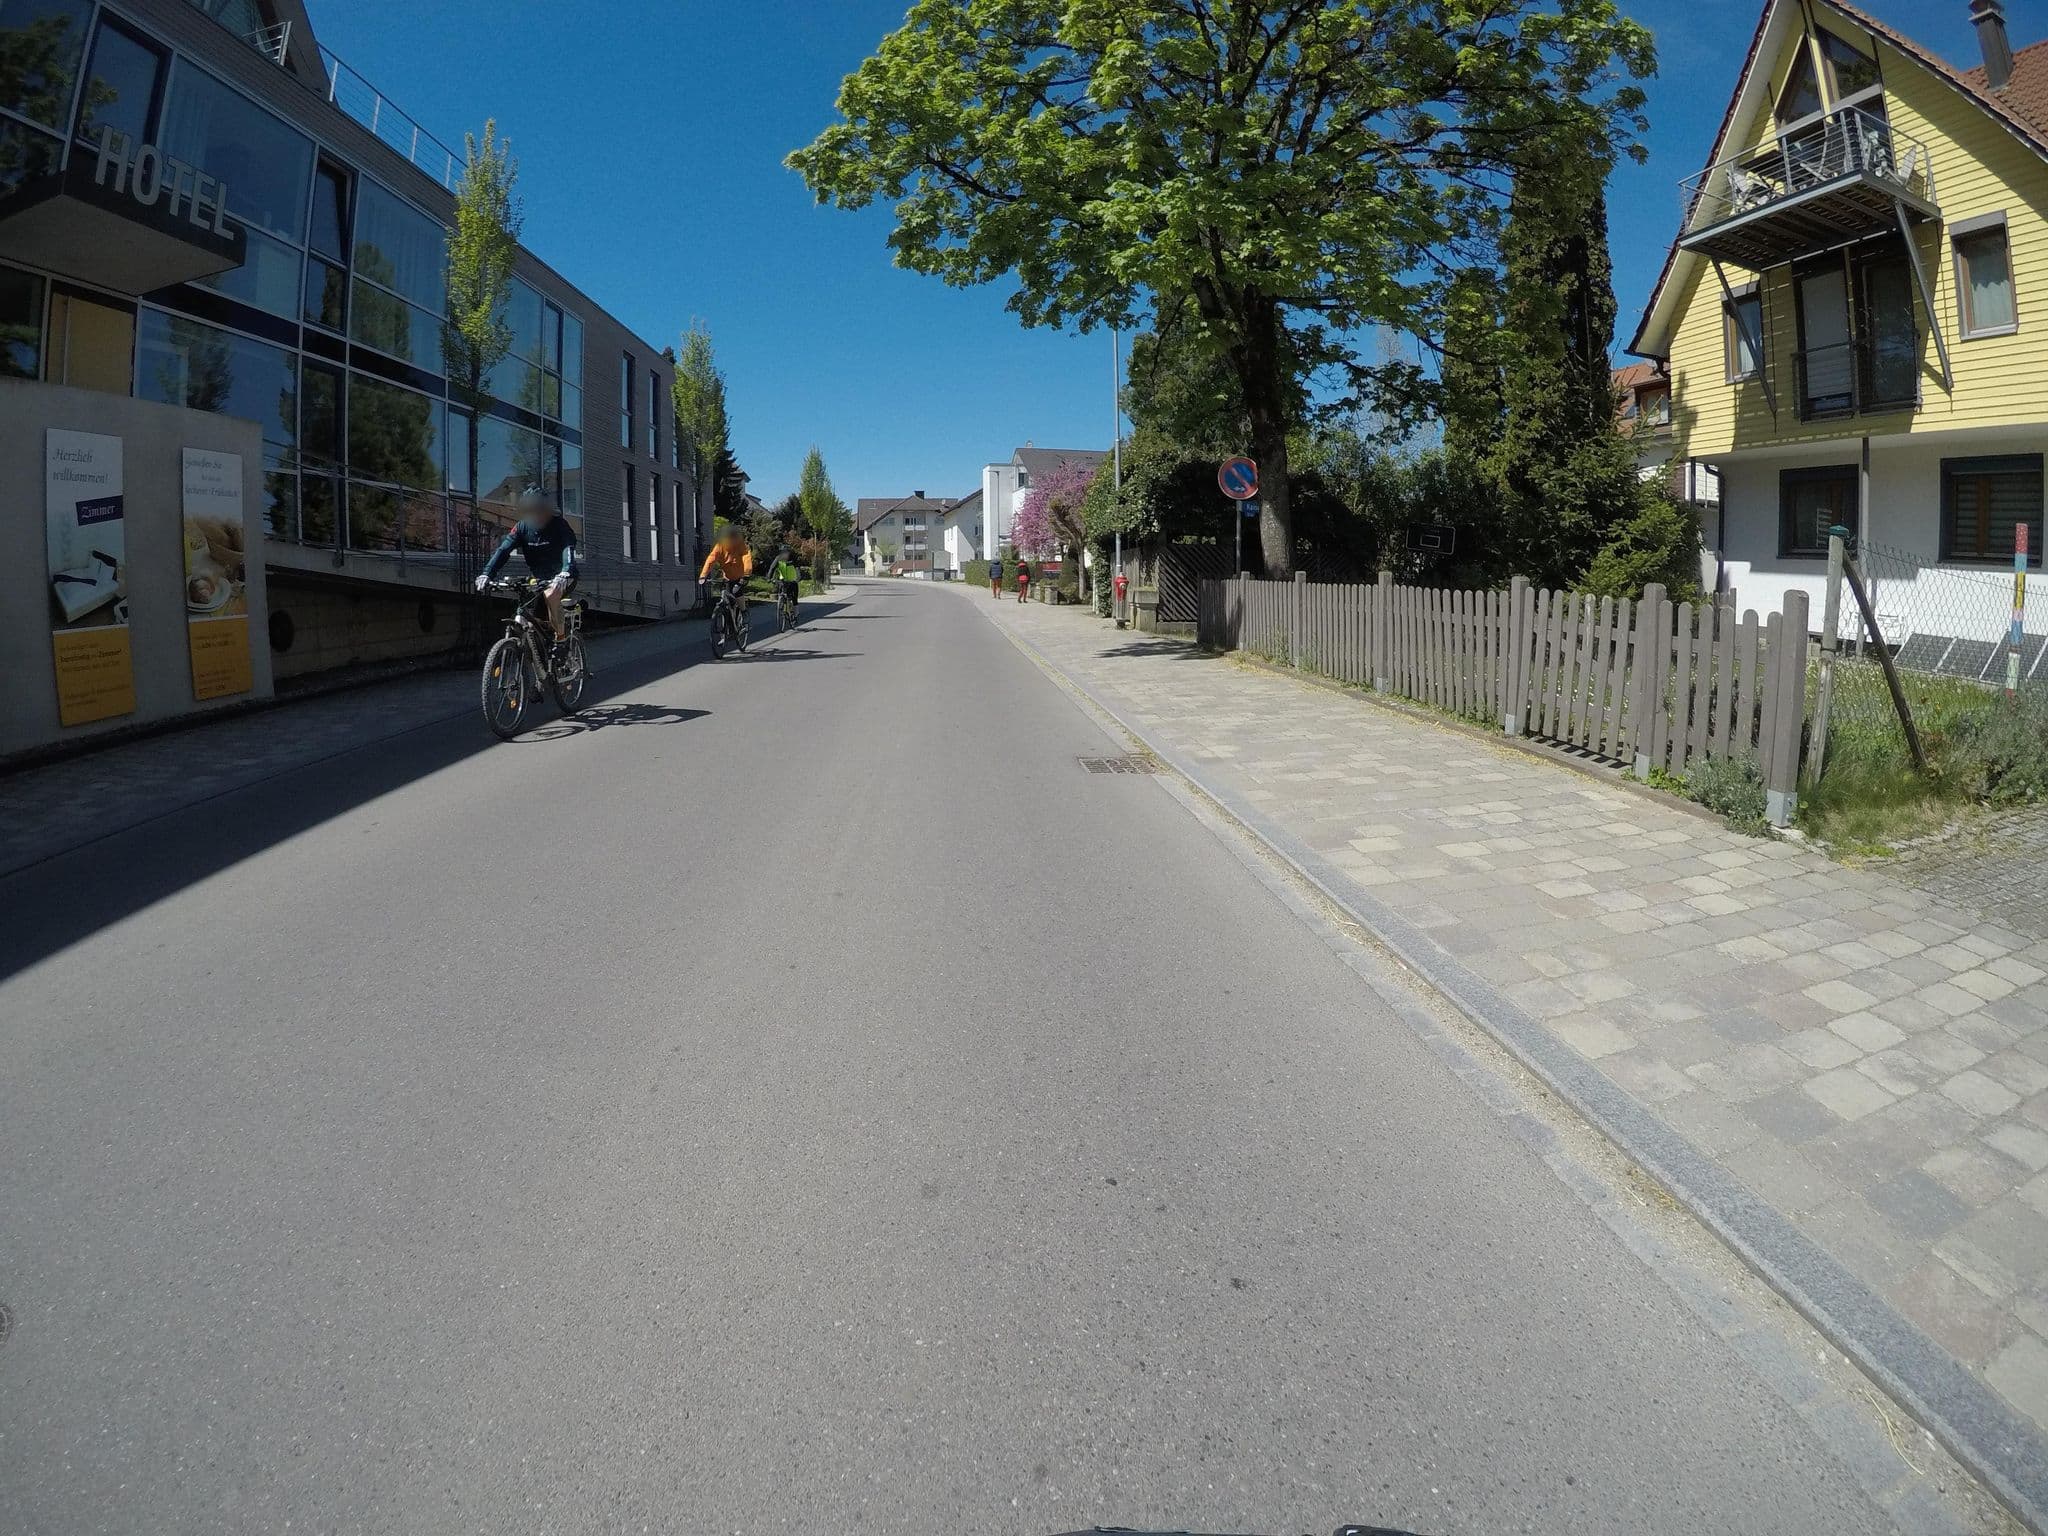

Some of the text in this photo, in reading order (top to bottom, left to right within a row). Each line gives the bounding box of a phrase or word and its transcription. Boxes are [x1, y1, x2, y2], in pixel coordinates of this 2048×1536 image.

[95, 125, 234, 240] HOTEL
[53, 449, 93, 463] Herzlich
[53, 468, 109, 484] willkommen!
[81, 505, 116, 519] Zimmer
